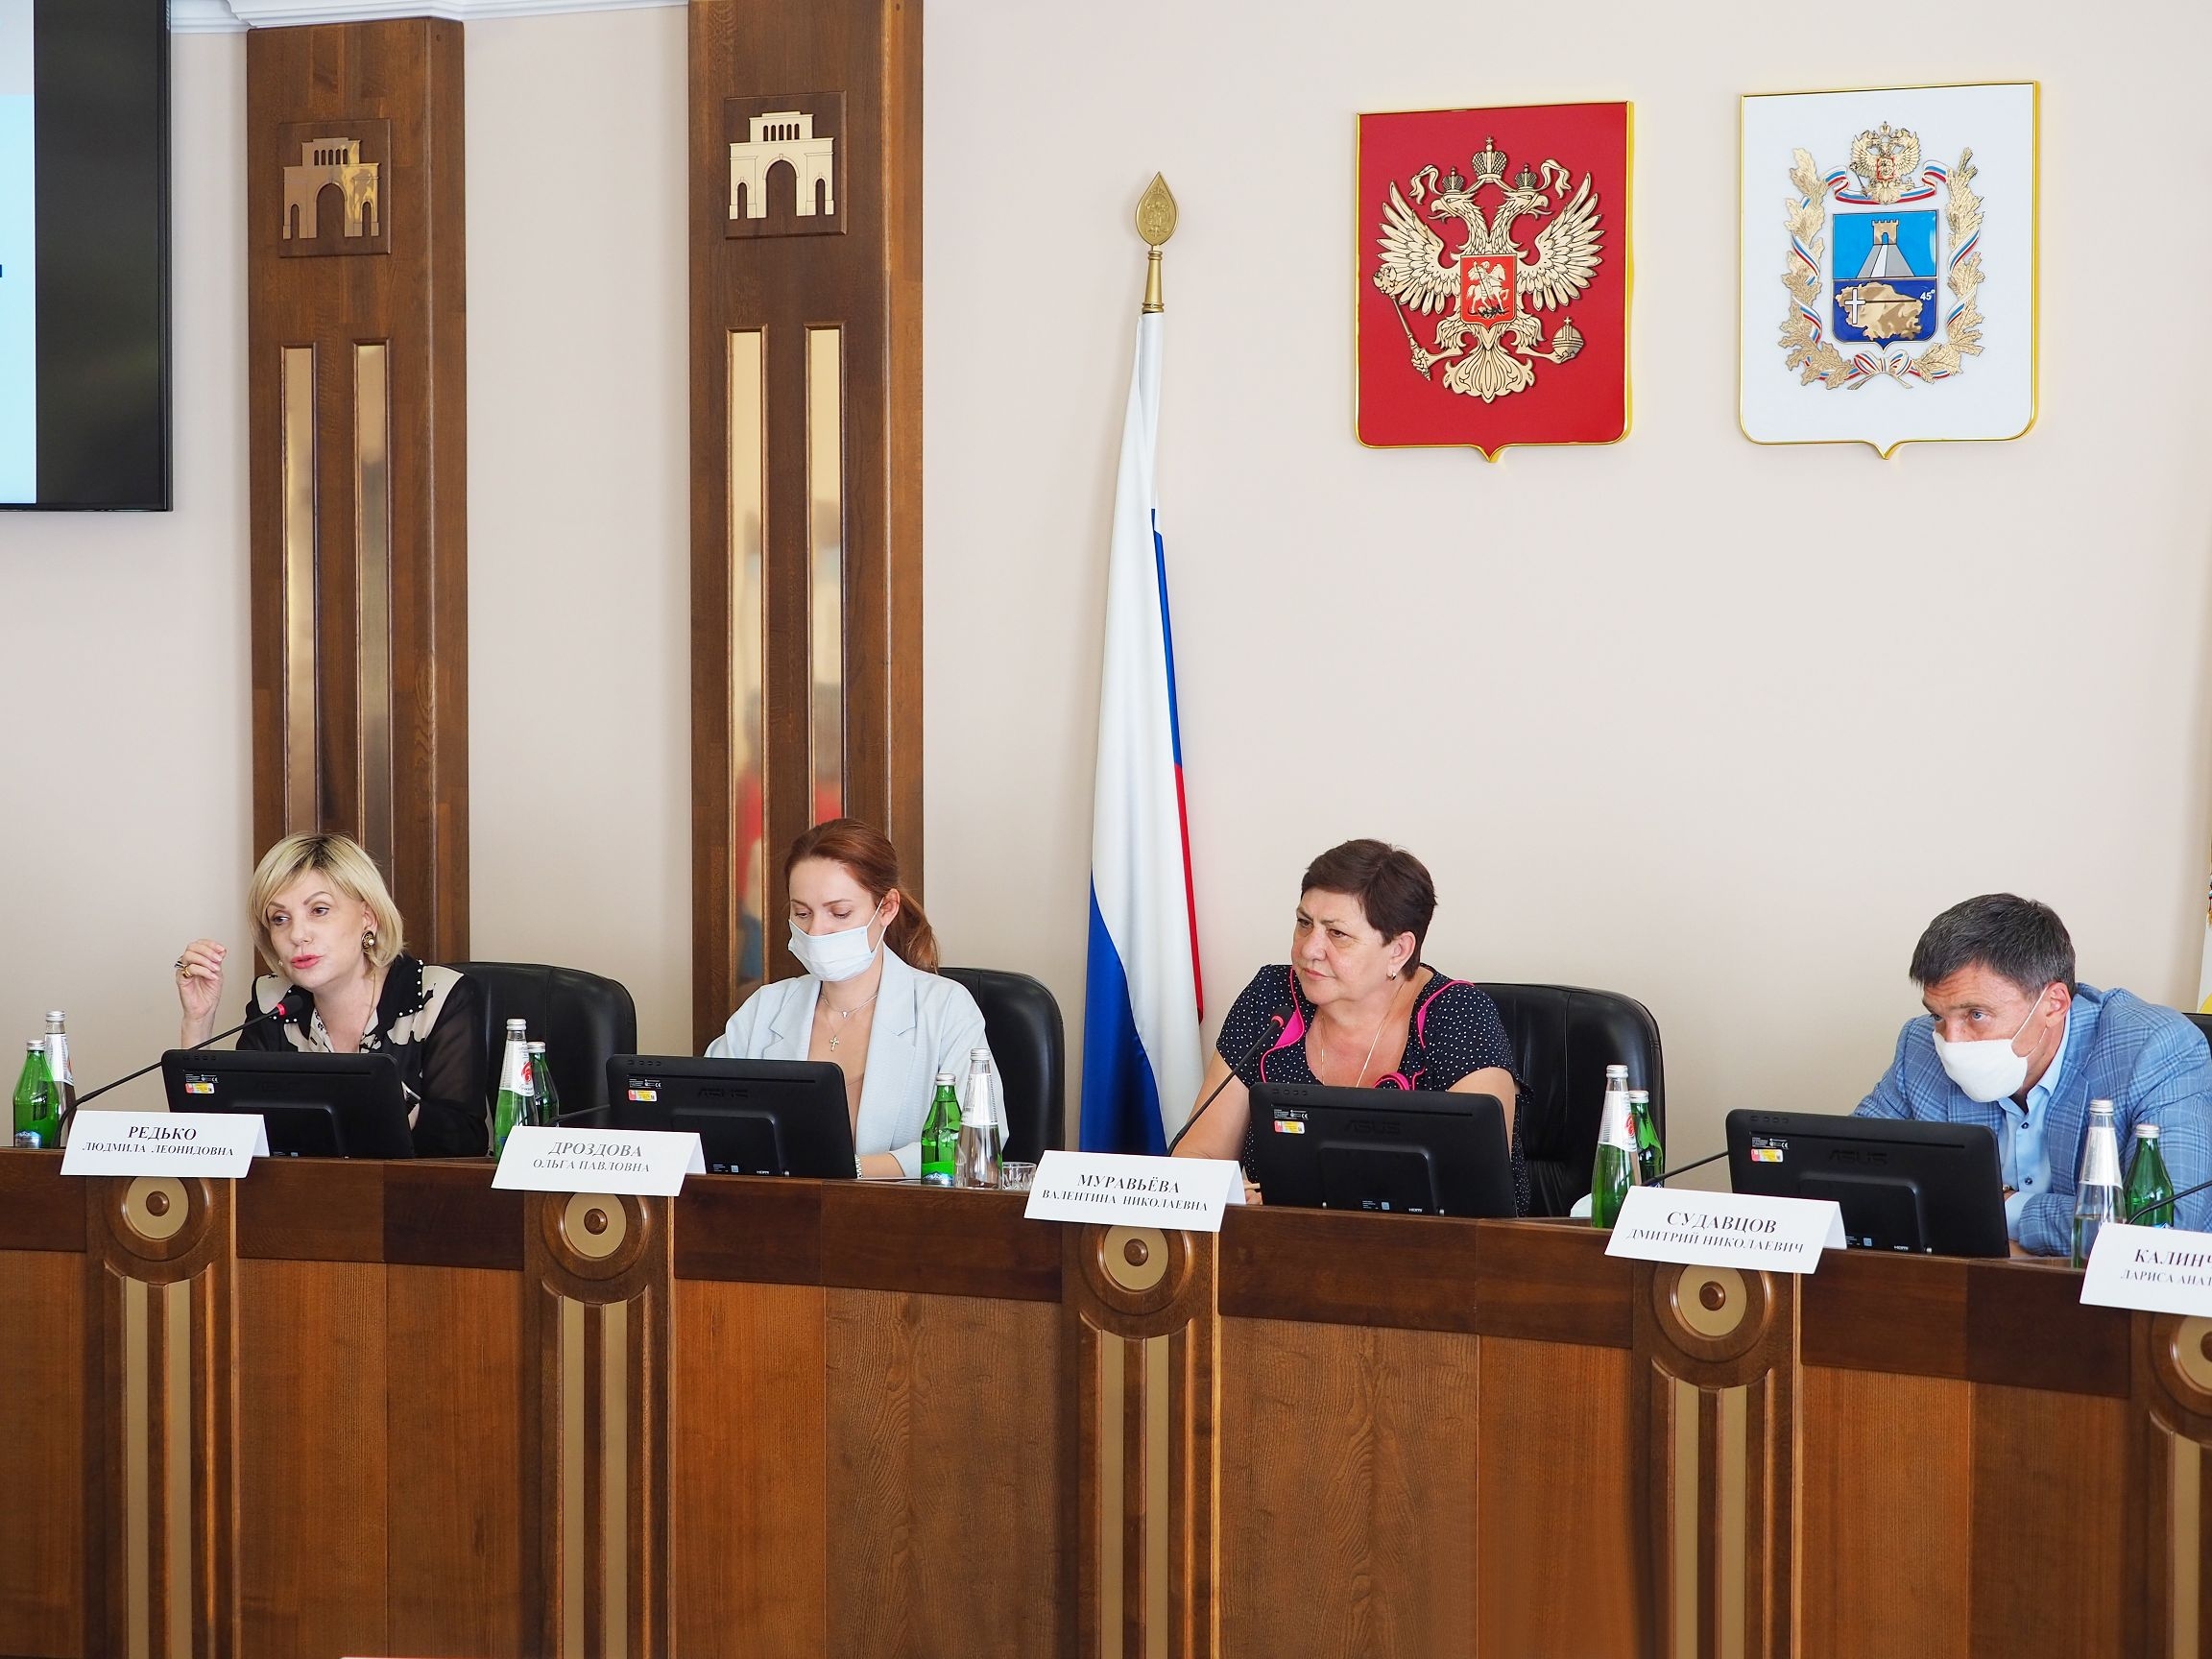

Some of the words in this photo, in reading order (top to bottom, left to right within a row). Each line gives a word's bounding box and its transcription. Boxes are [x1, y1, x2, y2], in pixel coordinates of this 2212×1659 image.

[127, 1126, 197, 1141] РЕДЬКО
[1344, 1119, 1401, 1135] ASUS
[83, 1142, 146, 1153] ЛЮДМИЛА
[152, 1143, 234, 1157] ЛЕОНИДОВНА
[548, 1142, 642, 1158] ДРОЗДОВА
[1829, 1149, 1887, 1166] ASUS
[533, 1158, 575, 1169] ОЛЬГА
[579, 1160, 650, 1172] ПАВЛОВНА
[1077, 1174, 1180, 1193] МУРАВЬЁВА
[1042, 1189, 1117, 1204] ВАЛЕНТИНА
[1122, 1195, 1208, 1212] НИКОЛАЕВНА
[1667, 1211, 1777, 1234] СУДАВЦОВ
[1626, 1228, 1699, 1245] ДМИТРИЙ
[1702, 1236, 1804, 1254] НИКОЛАЕВИЧ
[2121, 1269, 2173, 1284] ЛАРИСА
